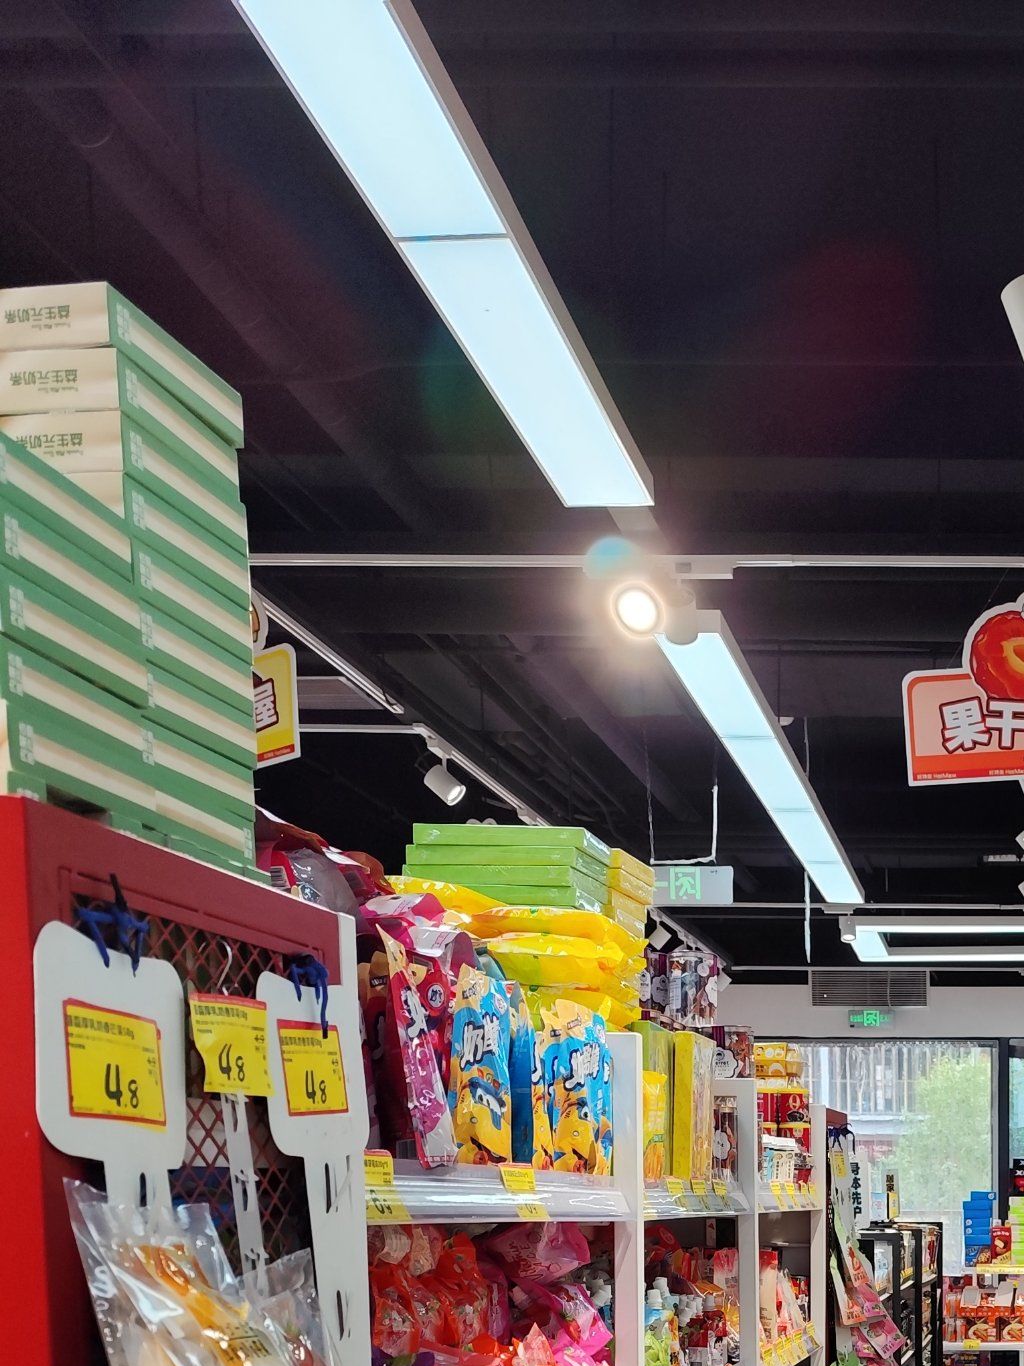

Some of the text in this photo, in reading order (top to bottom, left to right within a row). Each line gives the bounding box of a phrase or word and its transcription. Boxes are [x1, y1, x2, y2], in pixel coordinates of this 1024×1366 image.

[218, 1043, 246, 1084] 4.8
[104, 1062, 140, 1110] 4.8
[305, 1070, 327, 1105] 4.8
